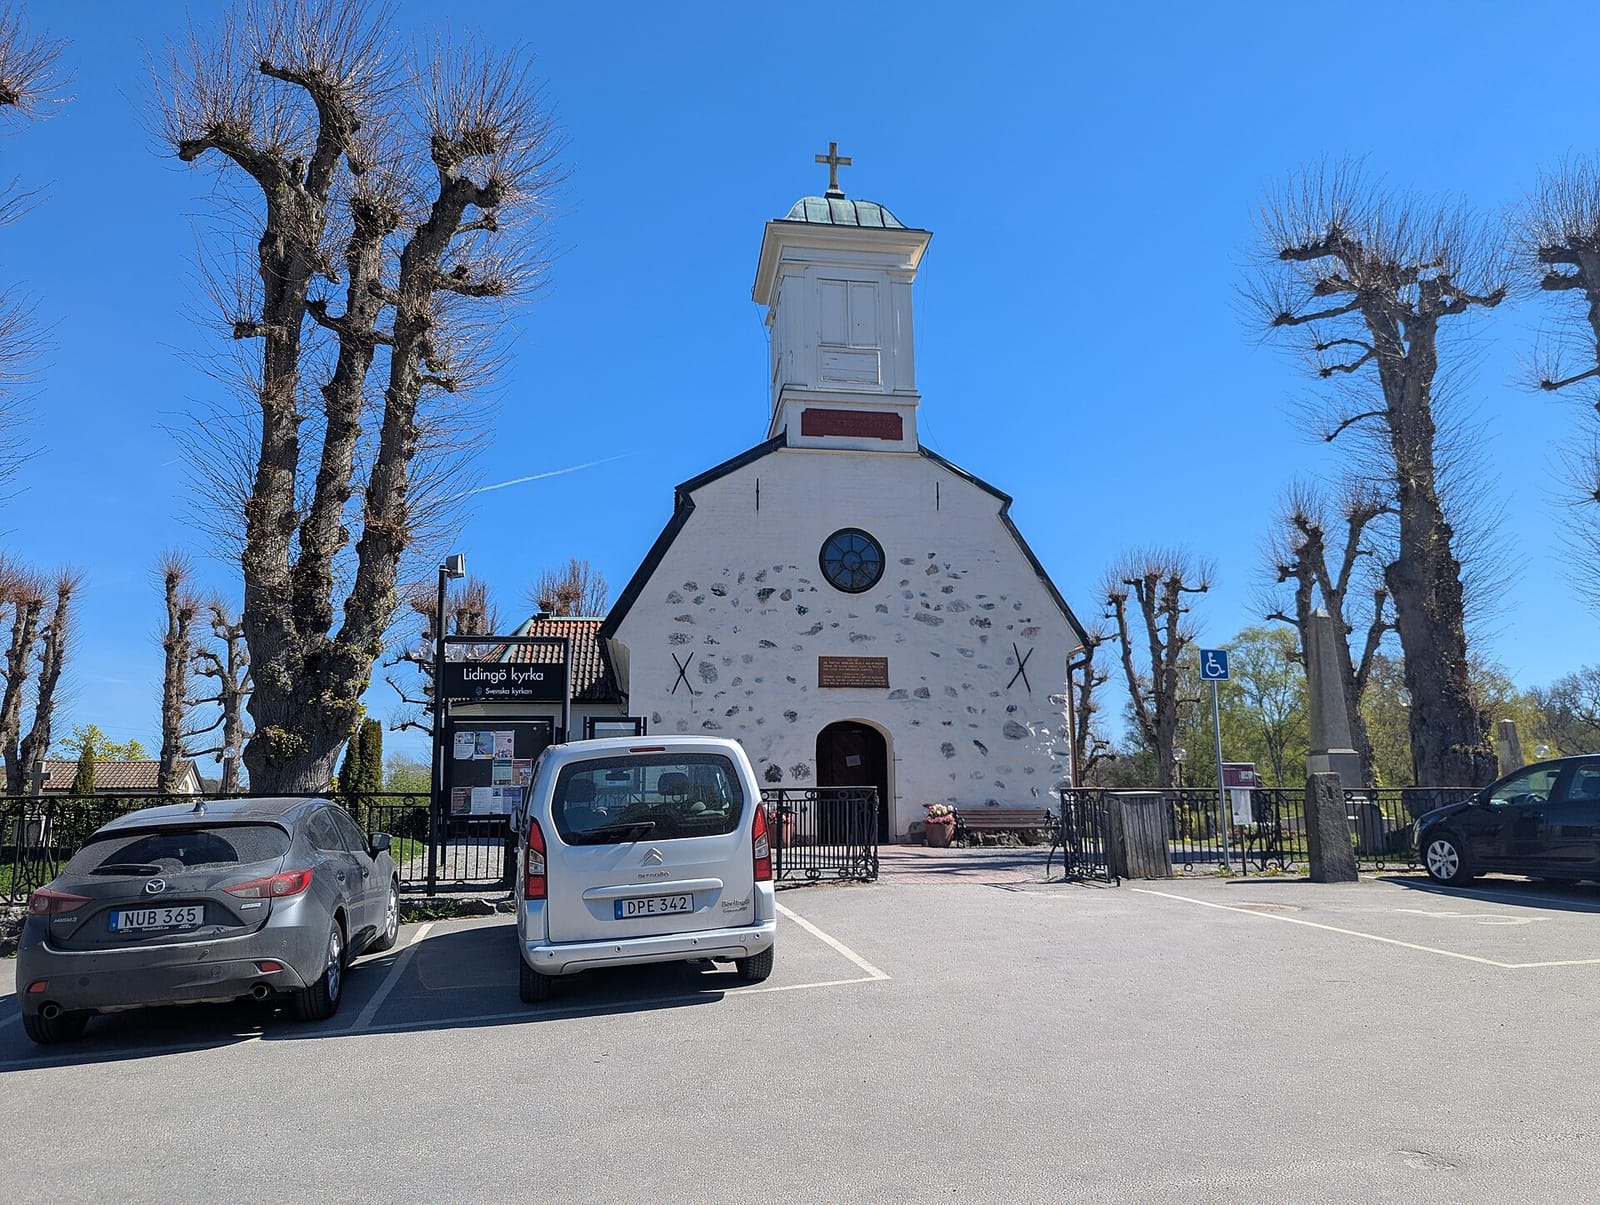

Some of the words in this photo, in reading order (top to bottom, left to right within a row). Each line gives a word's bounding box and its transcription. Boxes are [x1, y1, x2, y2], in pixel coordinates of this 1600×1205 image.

[463, 666, 507, 684] Lidingö
[511, 666, 544, 684] kyrka
[485, 687, 510, 695] Svenska
[511, 687, 533, 697] kyrkan
[627, 899, 656, 915] DPE
[660, 896, 688, 911] 342
[124, 911, 157, 928] NUB
[163, 907, 196, 924] 365
